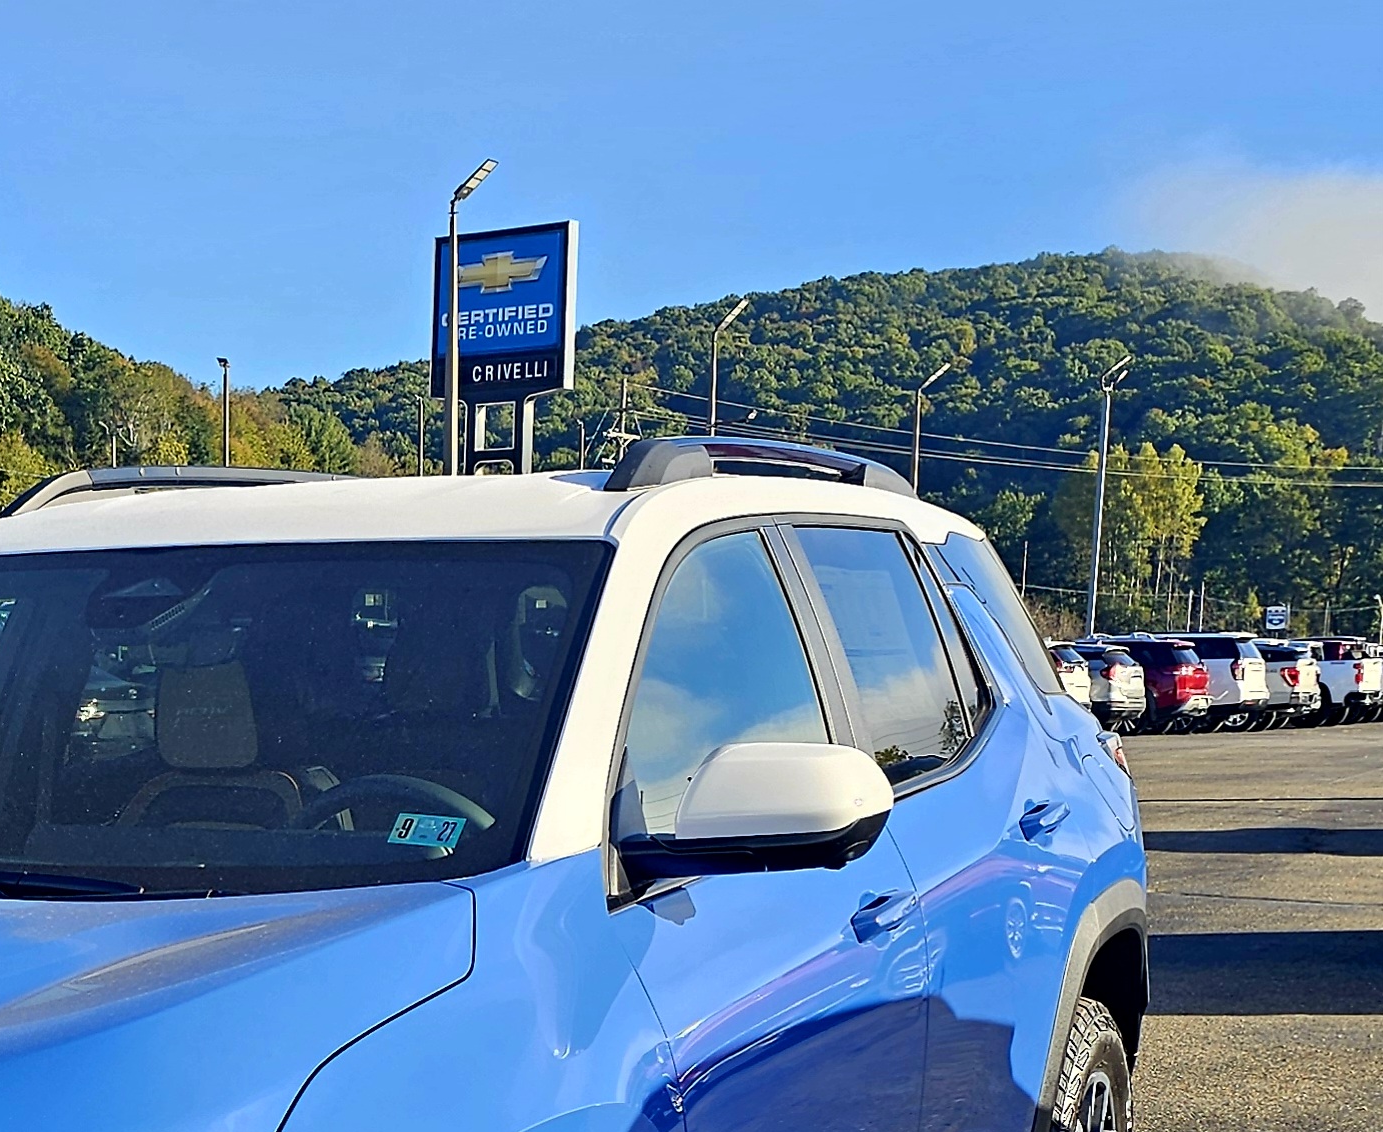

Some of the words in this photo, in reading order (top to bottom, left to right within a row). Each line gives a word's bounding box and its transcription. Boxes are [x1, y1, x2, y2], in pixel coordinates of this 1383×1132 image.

[458, 319, 548, 341] RE-OWNED
[472, 360, 548, 383] CRIVELLI
[397, 818, 415, 839] 9
[436, 821, 458, 842] 27
